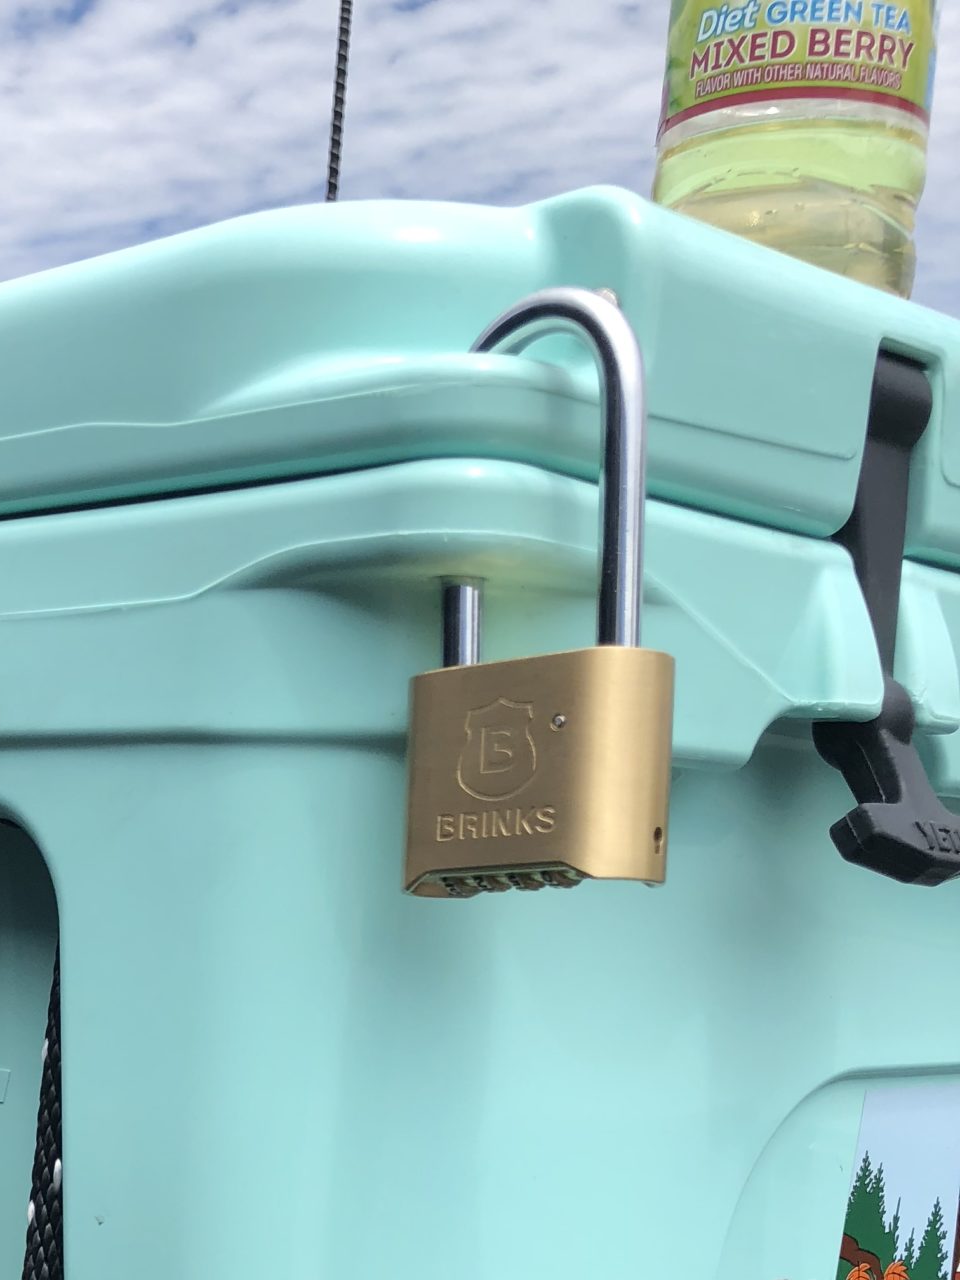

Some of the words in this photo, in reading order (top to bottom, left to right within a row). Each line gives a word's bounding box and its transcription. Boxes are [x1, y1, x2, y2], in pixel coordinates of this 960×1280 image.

[696, 1, 760, 43] Diet
[766, 0, 862, 26] GREEN
[871, 3, 912, 35] TEA
[689, 30, 796, 80] MIXED
[808, 28, 916, 70] BERRY
[695, 73, 731, 98] FLAVOR
[733, 66, 761, 89] WITH
[764, 63, 804, 82] OTHER
[806, 63, 857, 81] NATURAL
[859, 66, 901, 90] FLAVORS
[436, 805, 557, 842] BRINKS
